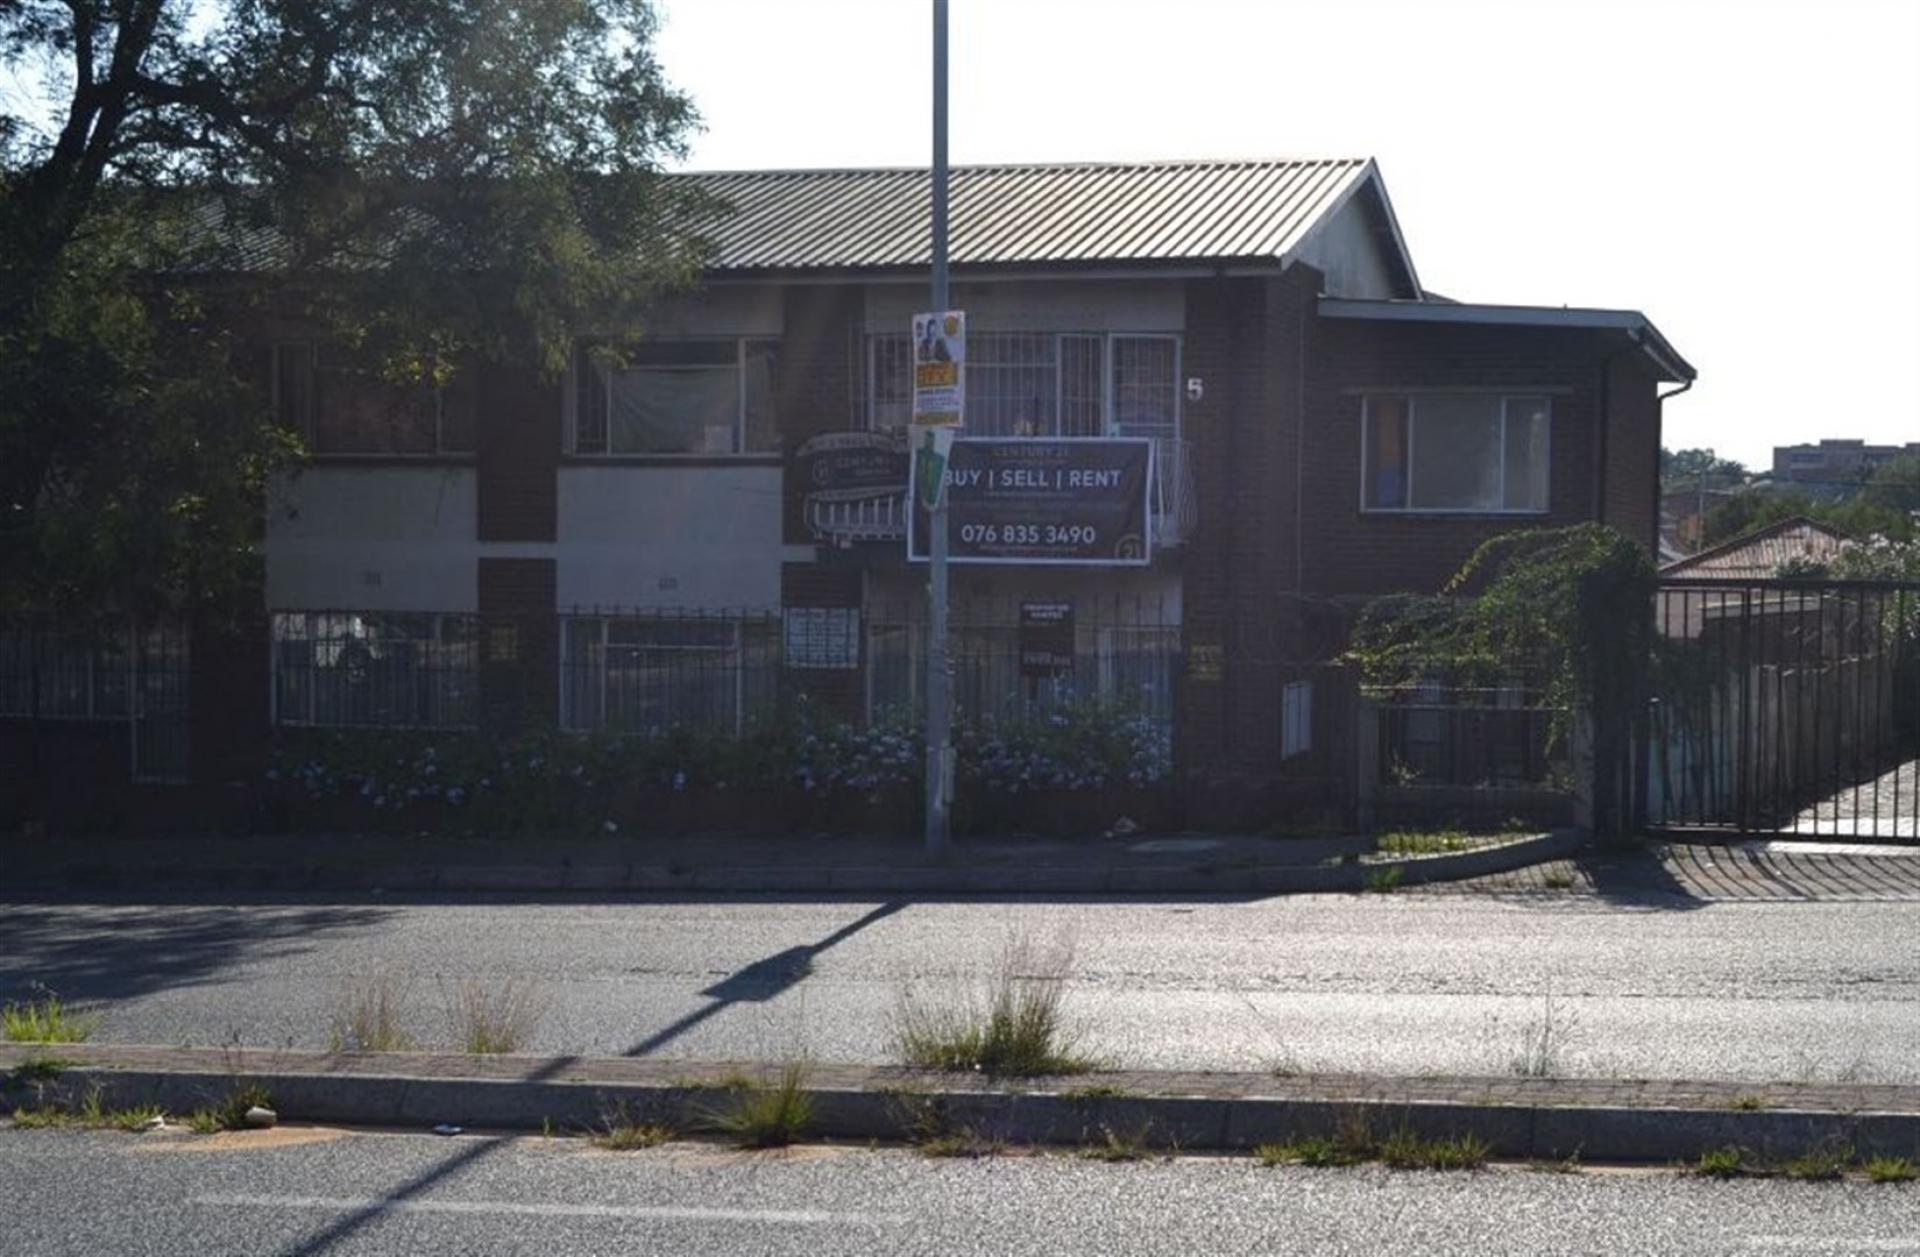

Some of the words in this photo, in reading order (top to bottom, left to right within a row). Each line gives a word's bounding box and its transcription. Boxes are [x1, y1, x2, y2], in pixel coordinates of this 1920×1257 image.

[1187, 377, 1203, 401] 5
[945, 469, 982, 487] BUY
[1001, 469, 1049, 487] SELL
[1069, 469, 1121, 487] RENT
[961, 524, 997, 543] 076
[1002, 525, 1040, 543] 835
[1045, 525, 1097, 544] 3490
